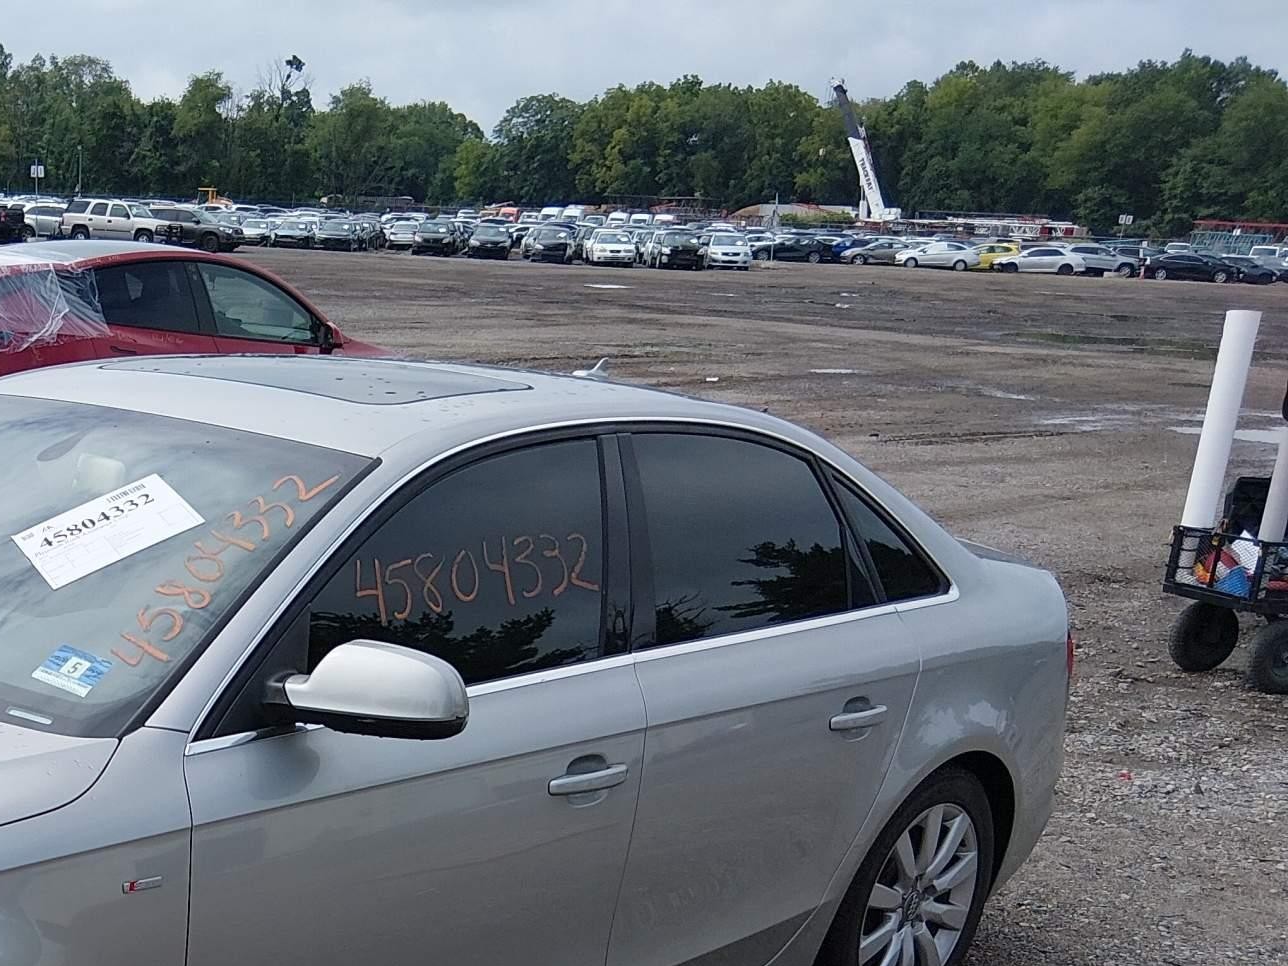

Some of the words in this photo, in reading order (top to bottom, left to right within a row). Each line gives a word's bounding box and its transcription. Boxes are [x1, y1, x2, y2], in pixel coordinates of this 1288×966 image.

[40, 493, 154, 548] 45804332
[111, 474, 341, 665] 45804332
[355, 533, 600, 625] 45804332
[67, 662, 82, 674] 5
